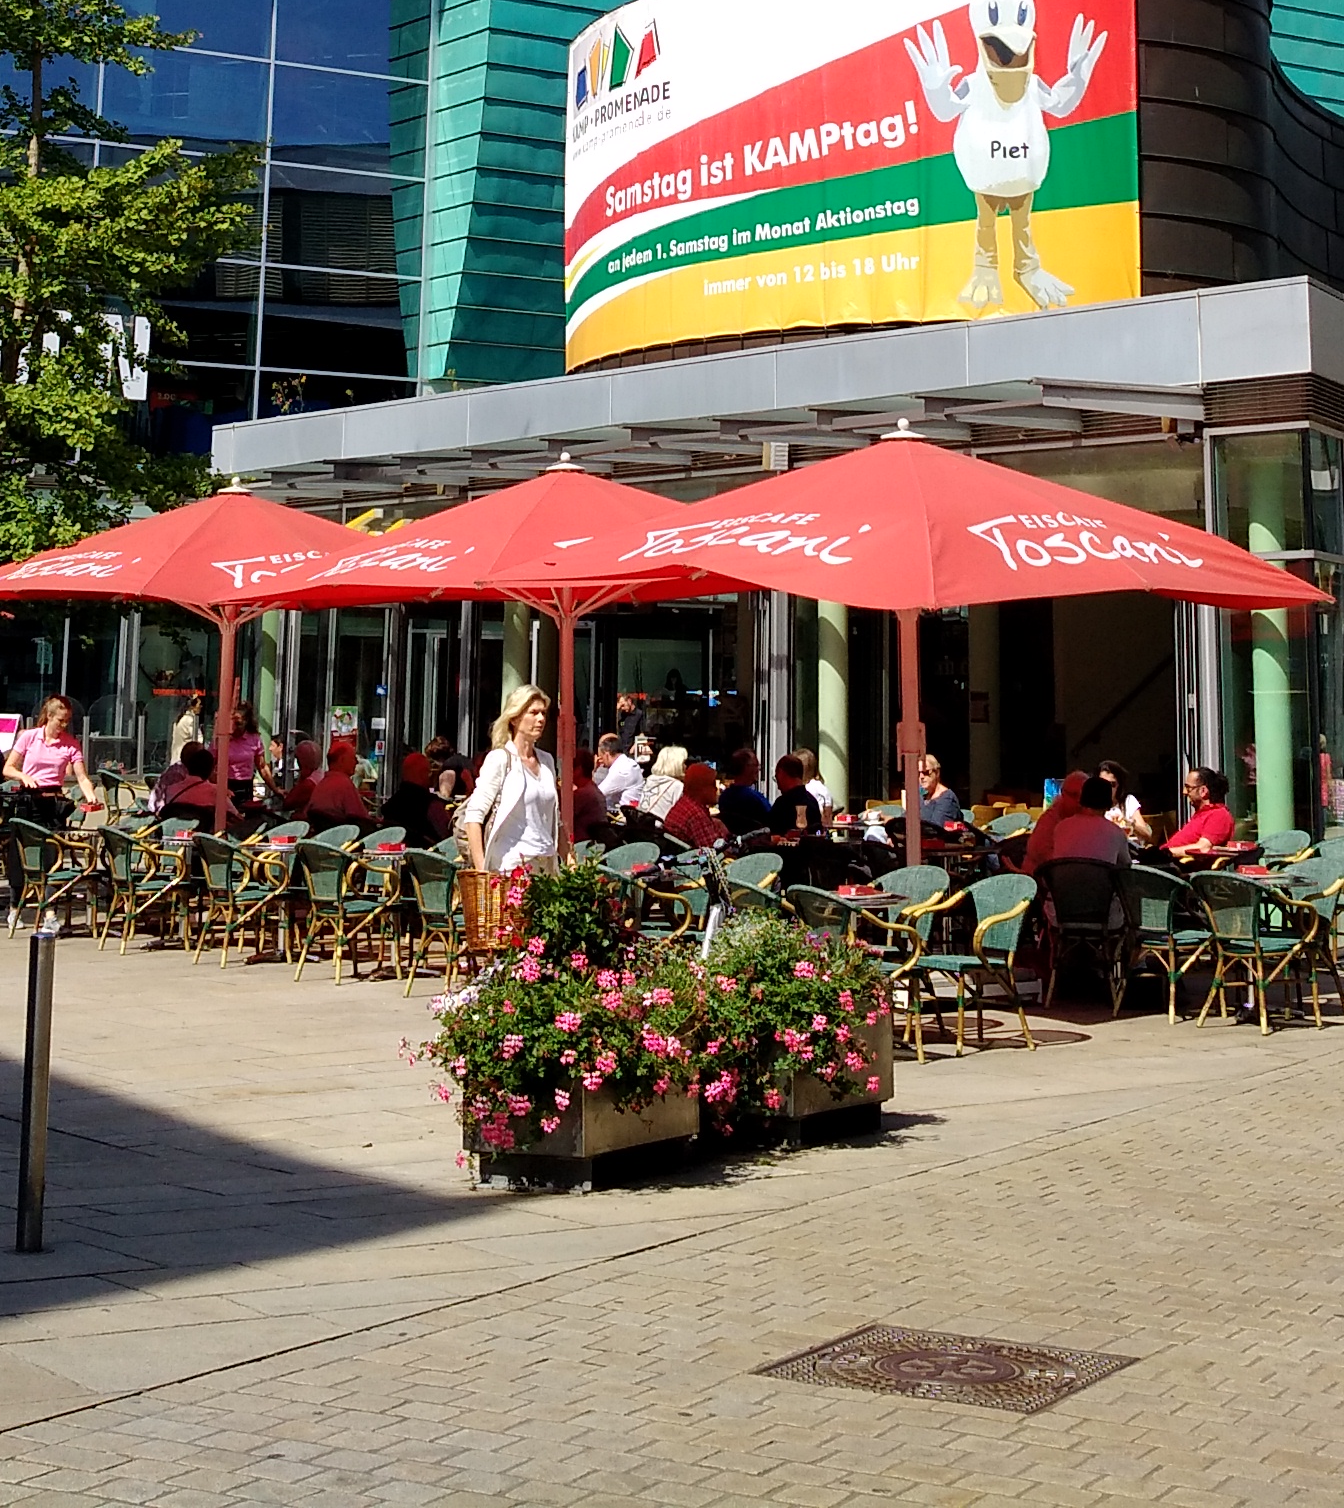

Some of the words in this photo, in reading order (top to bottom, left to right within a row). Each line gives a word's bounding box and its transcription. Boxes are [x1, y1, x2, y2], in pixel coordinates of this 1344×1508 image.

[595, 81, 671, 127] PROMENADE
[605, 167, 693, 217] Samstag
[700, 155, 735, 186] ist
[743, 100, 919, 176] KAMPtag!
[991, 140, 1029, 159] Piet
[608, 258, 621, 274] an
[622, 245, 653, 273] jedem
[656, 244, 667, 260] 1.
[669, 232, 728, 258] Samstag
[732, 228, 751, 246] im
[755, 216, 811, 241] Monat
[816, 197, 920, 231] Aktionstag
[703, 278, 751, 295] immer
[756, 270, 788, 288] von
[793, 265, 814, 283] 12
[820, 260, 846, 279] bis
[852, 258, 875, 276] 18
[881, 253, 920, 273] Uhr
[966, 515, 1204, 571] Toscani
